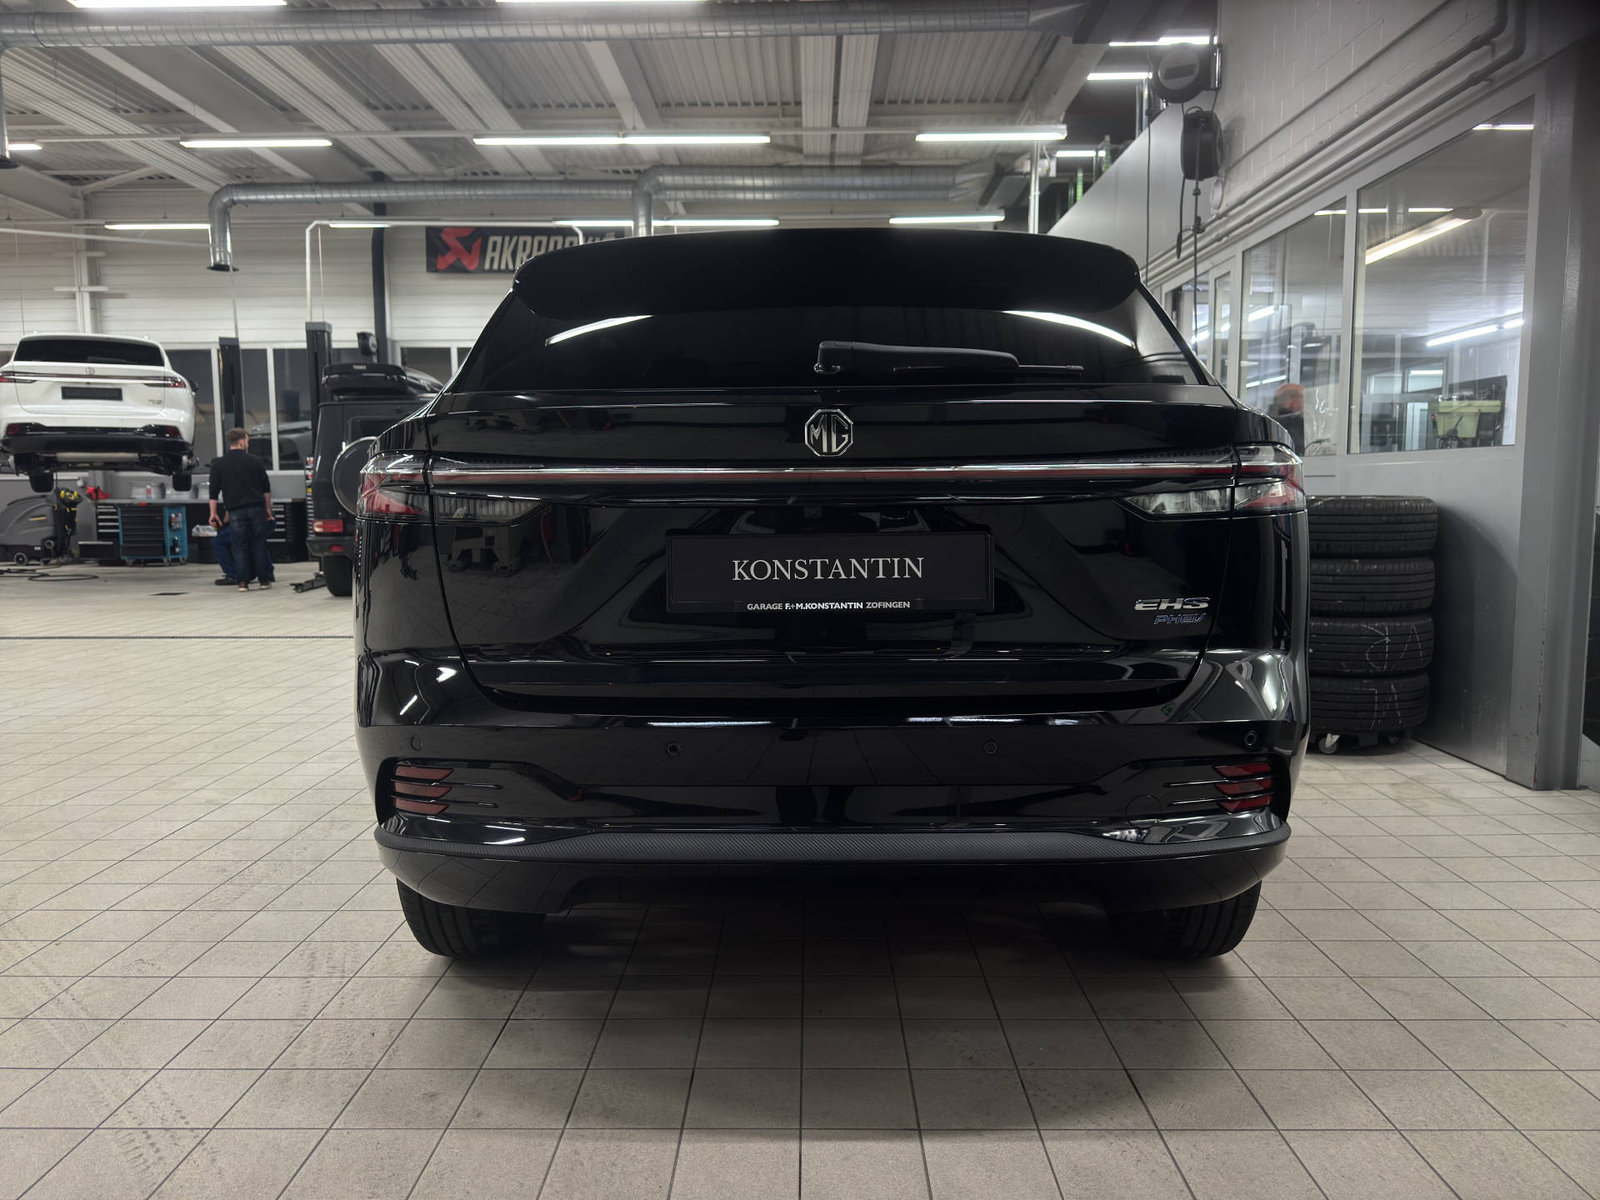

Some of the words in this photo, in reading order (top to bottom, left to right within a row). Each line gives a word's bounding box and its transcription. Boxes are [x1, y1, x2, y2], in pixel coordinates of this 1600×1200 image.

[808, 413, 850, 454] MG
[732, 557, 925, 581] KONSTANTIN
[747, 602, 783, 611] GARAGE
[865, 601, 911, 609] ZOFINGEN
[1134, 597, 1211, 611] EHS
